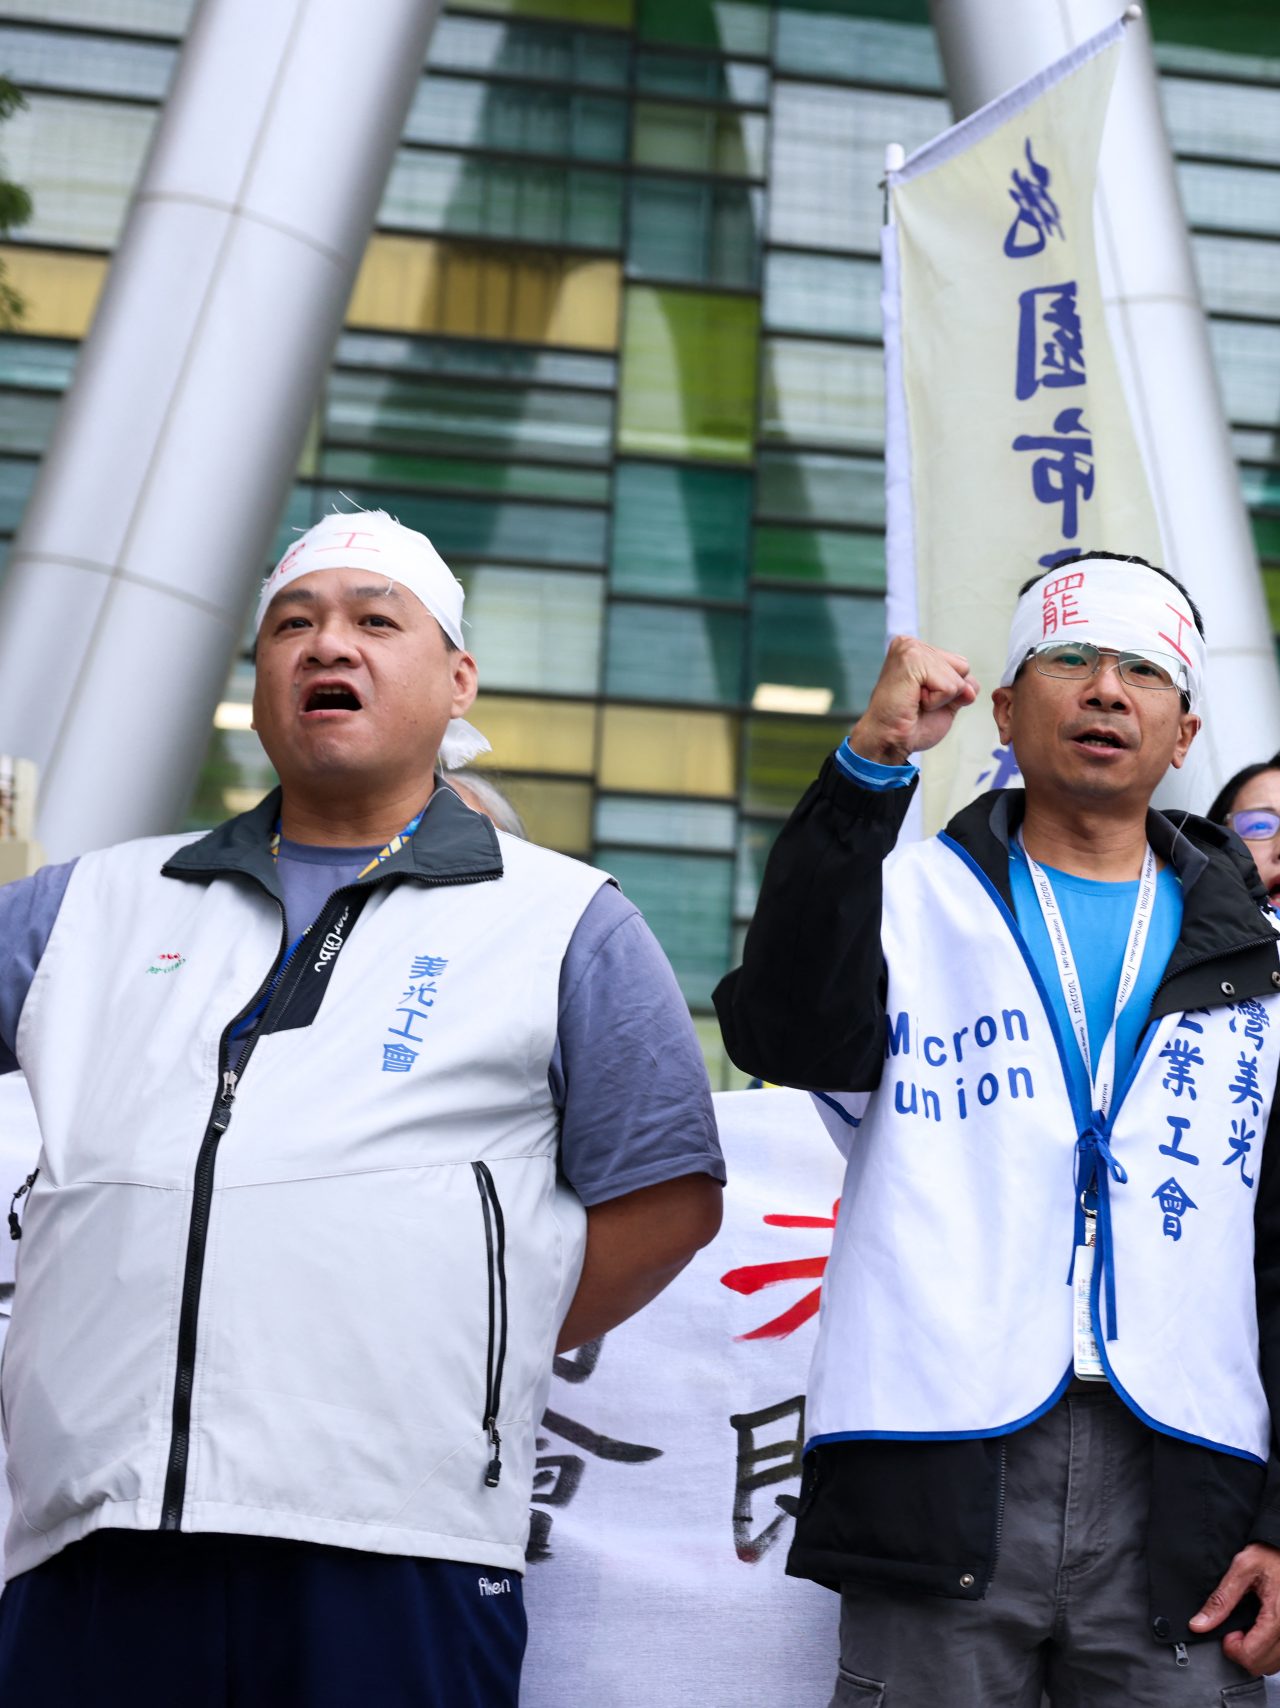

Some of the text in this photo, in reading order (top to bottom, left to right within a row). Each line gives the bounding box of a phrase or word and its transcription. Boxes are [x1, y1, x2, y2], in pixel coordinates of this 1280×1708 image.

[1042, 572, 1194, 669] 罷工
[382, 955, 449, 1073] 美光工會
[1068, 980, 1082, 1014] micron
[884, 1009, 1030, 1067] Mcron
[895, 1067, 1035, 1122] union
